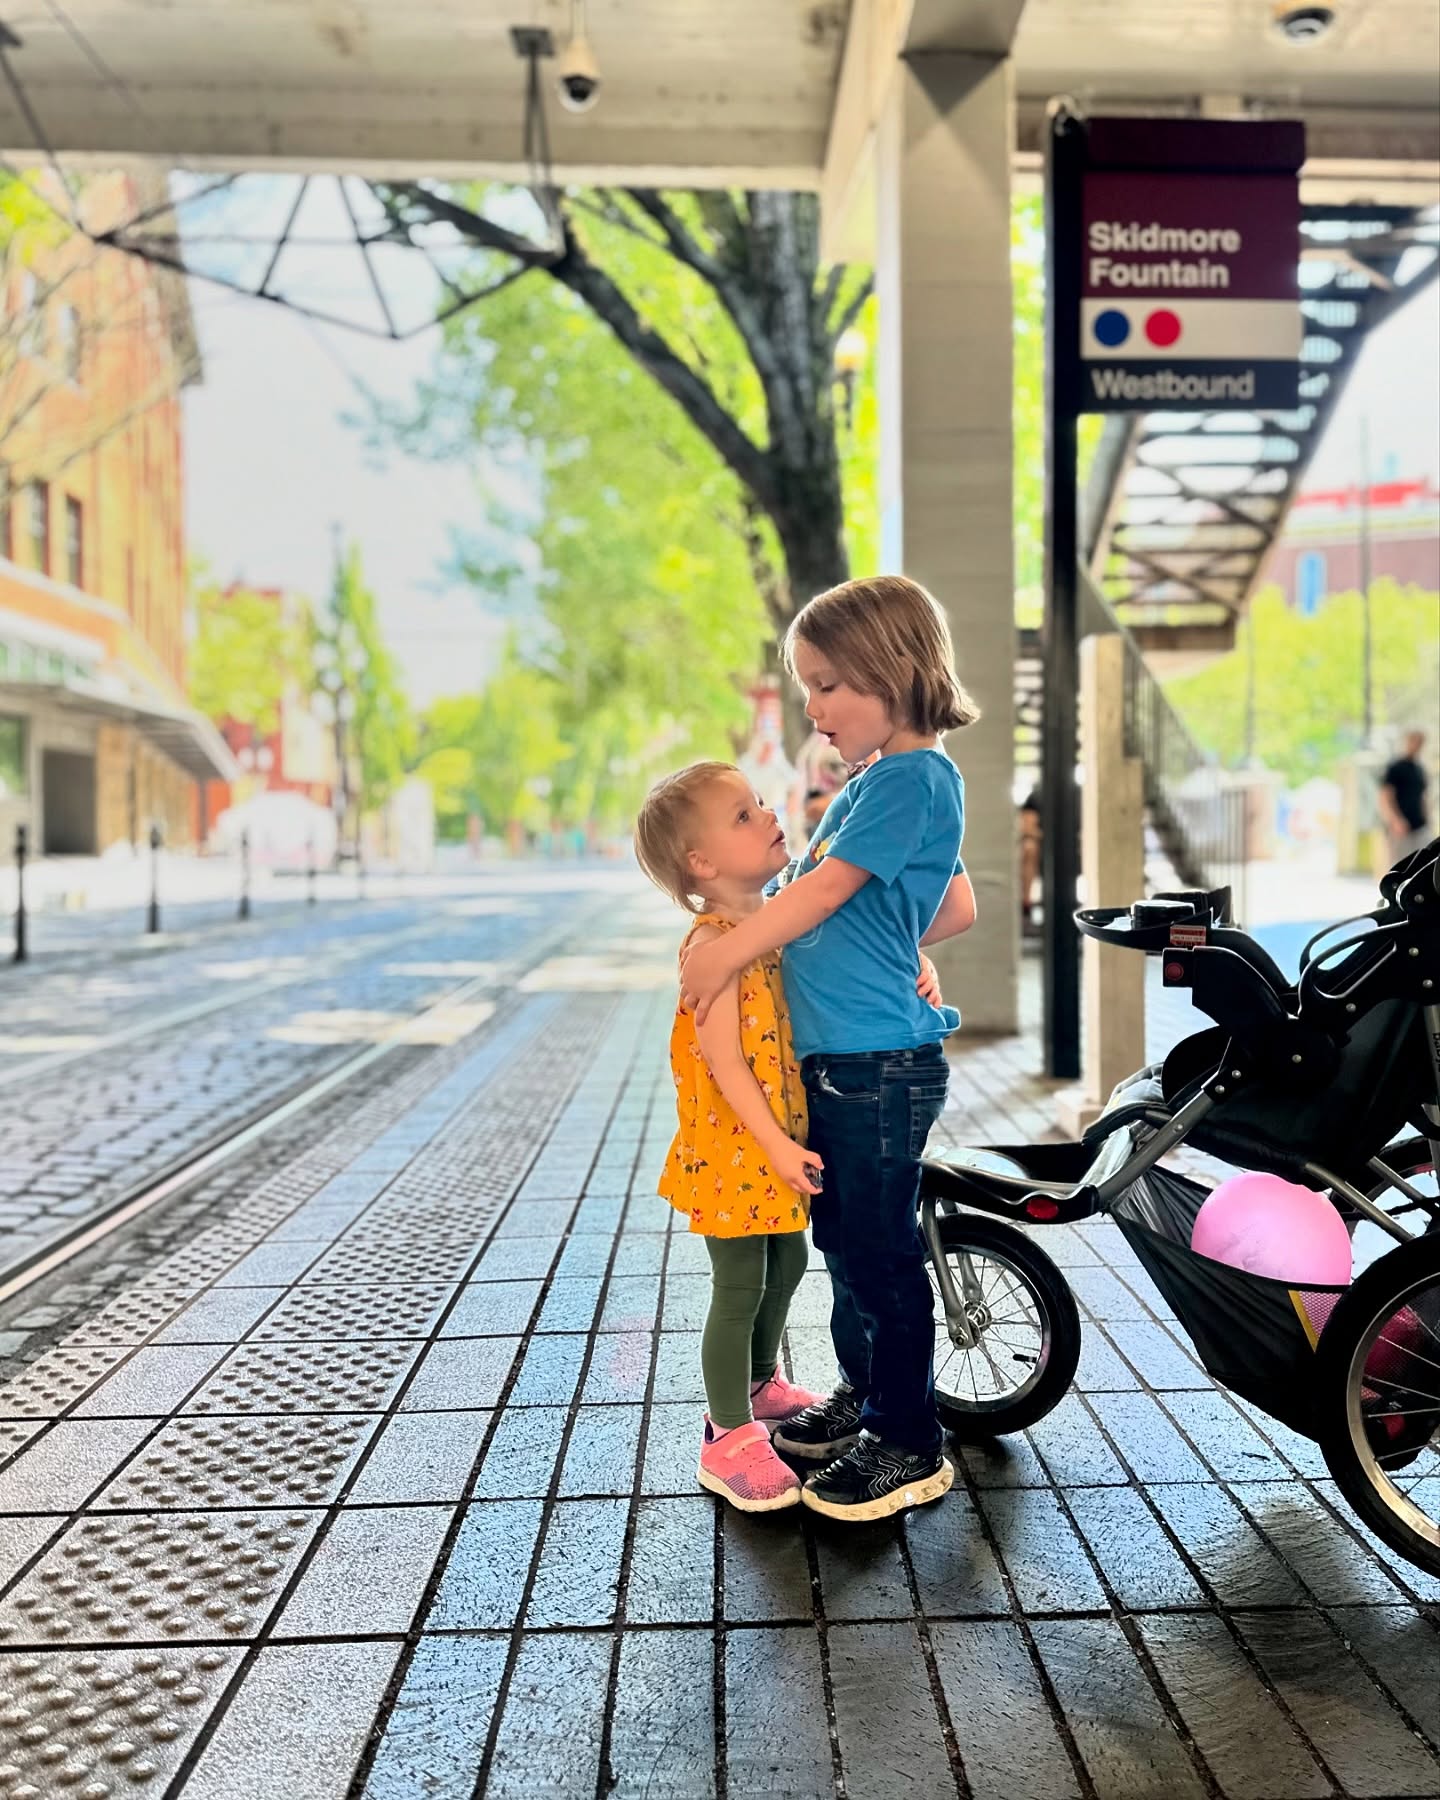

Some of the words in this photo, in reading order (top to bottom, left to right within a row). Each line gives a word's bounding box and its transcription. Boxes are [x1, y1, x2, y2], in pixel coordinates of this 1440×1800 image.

[1089, 221, 1241, 252] Skidmore
[1089, 257, 1229, 287] Fountain
[1091, 368, 1255, 399] Westbound
